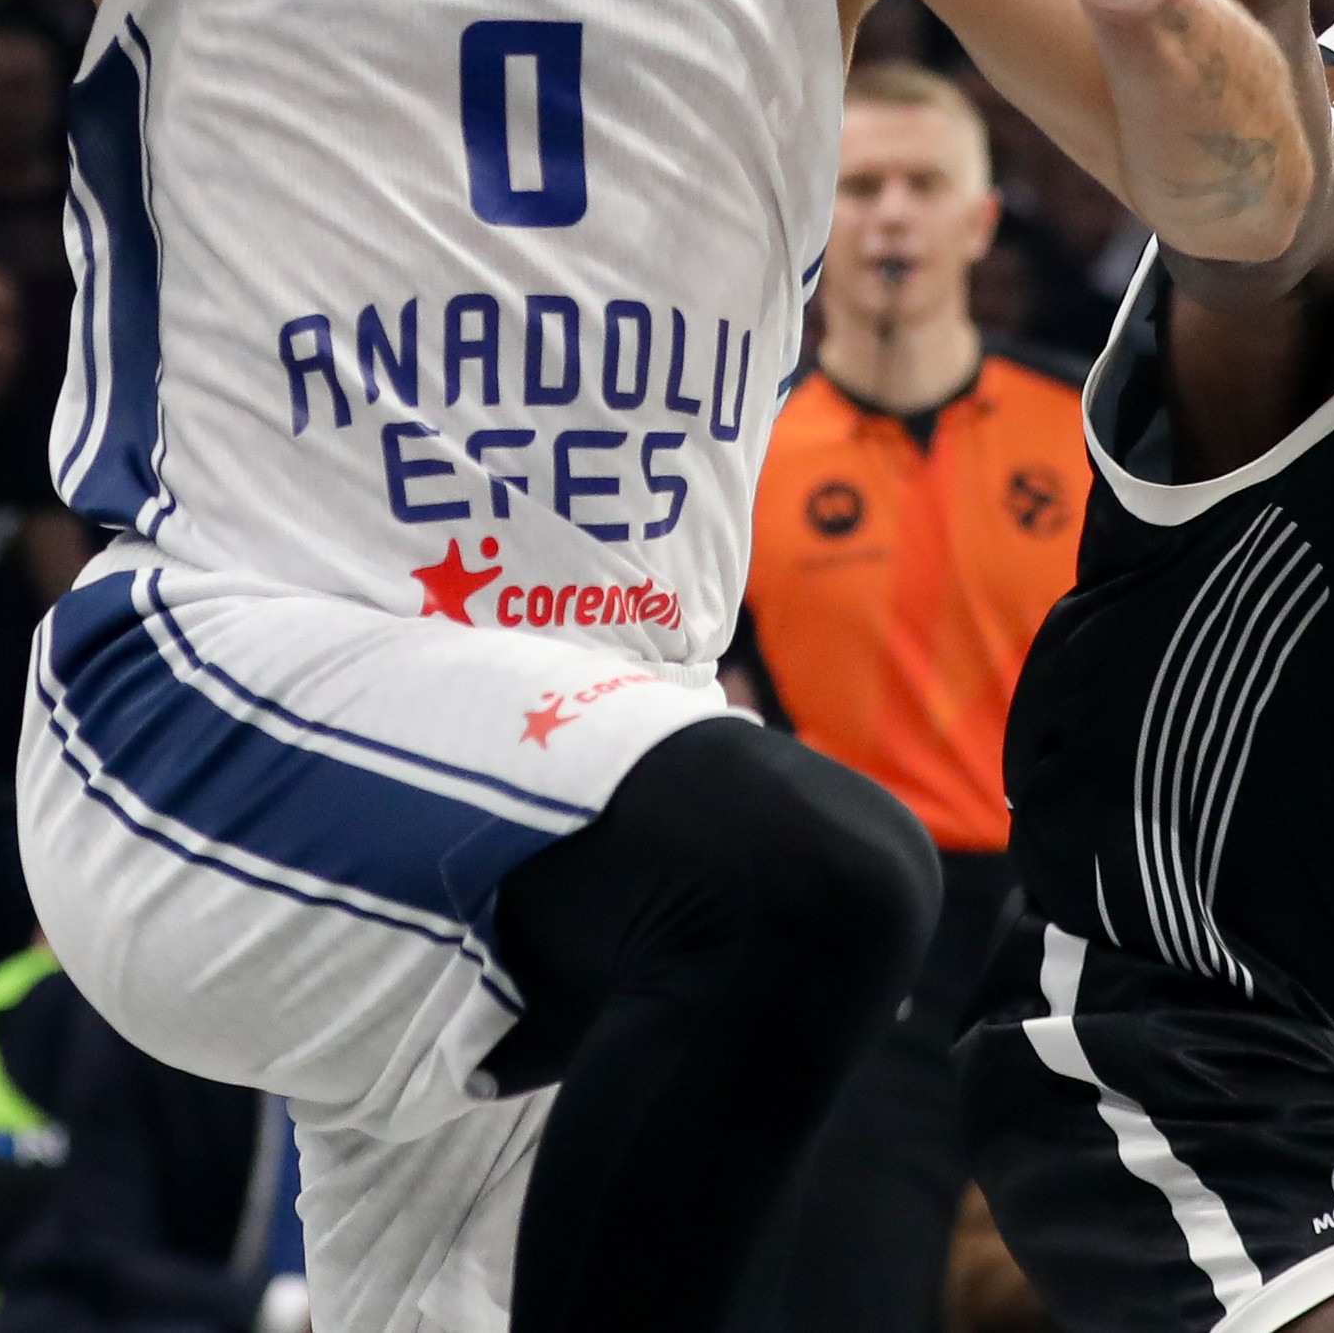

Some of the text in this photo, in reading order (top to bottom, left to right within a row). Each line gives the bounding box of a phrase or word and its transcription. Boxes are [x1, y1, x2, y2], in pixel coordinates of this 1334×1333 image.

[460, 20, 588, 228] 0
[279, 293, 751, 442] ANADOLU
[380, 422, 687, 542] EFES
